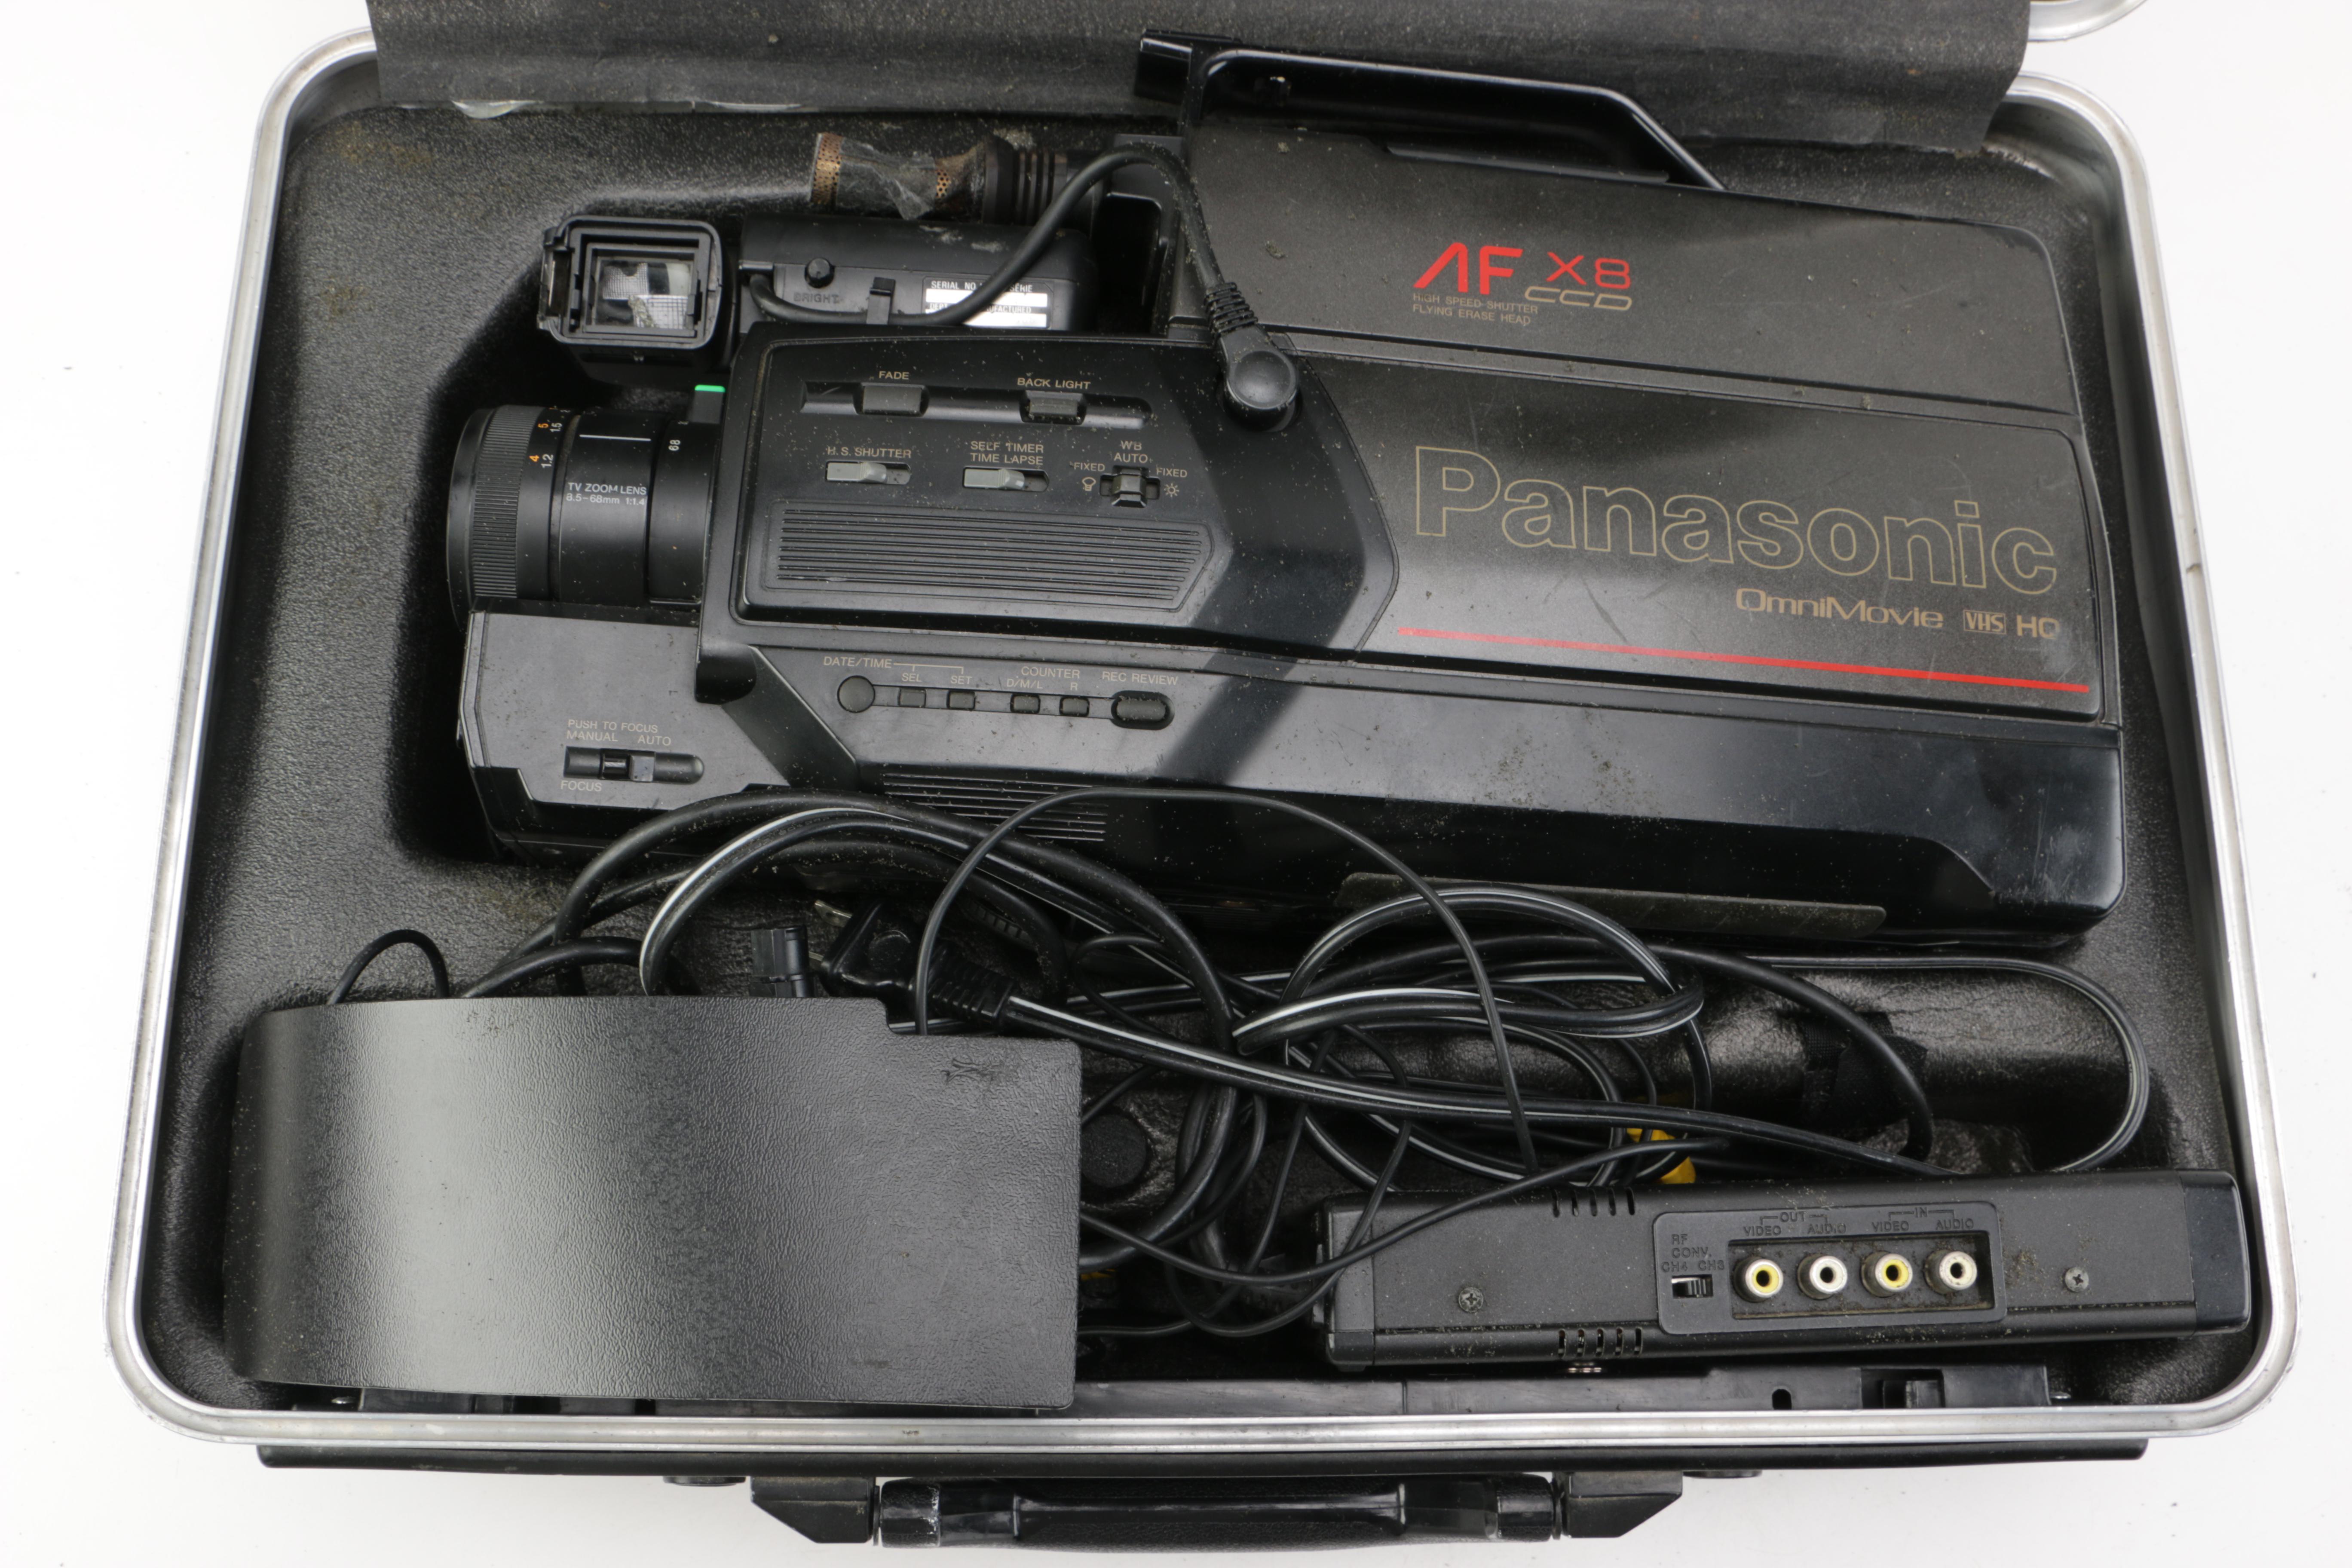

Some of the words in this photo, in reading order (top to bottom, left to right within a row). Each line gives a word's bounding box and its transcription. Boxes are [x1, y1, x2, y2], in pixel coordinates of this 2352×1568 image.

[1413, 242, 1523, 295] AF
[1546, 251, 1631, 289] X8
[931, 280, 959, 289] SERIAL
[794, 292, 839, 303] BRIGHT
[1413, 293, 1439, 303] HIGH
[1445, 296, 1481, 308] SPEED
[1487, 300, 1538, 314] SHUTTER
[1524, 286, 1632, 311] CCD
[1413, 304, 1452, 316] FLYING
[1458, 309, 1495, 321] ERASE
[1501, 314, 1531, 325] HEAD
[879, 371, 909, 380] FADE
[1017, 377, 1050, 387] BACK
[1056, 380, 1091, 389] LIGHT
[668, 439, 681, 451] 68
[971, 441, 1000, 451] SELF
[1007, 442, 1044, 453] TIMER
[1121, 440, 1142, 450] WB
[854, 447, 912, 458] SHUTTER
[1114, 453, 1148, 463] AUTO
[541, 454, 554, 468] 1.2
[970, 453, 1000, 462] TIME
[1004, 454, 1044, 465] LAPSE
[1074, 462, 1105, 472] FIXED
[1156, 467, 1188, 478] FIXED
[568, 482, 582, 492] TV
[585, 483, 618, 493] ZOOM
[620, 486, 647, 495] LENS
[625, 496, 645, 506] 1:1.4
[1414, 445, 2058, 594] Panasonic
[1736, 588, 1944, 628] OmniMovie
[1964, 610, 2005, 634] VHS
[2016, 614, 2060, 640] HQ
[823, 656, 893, 668] DATE/TIME
[901, 673, 922, 682] SEL
[1021, 666, 1080, 679] COUNTER
[1102, 671, 1127, 682] REC
[1131, 673, 1178, 686] REVIEW
[950, 675, 972, 684] SET
[1006, 678, 1043, 689] D/M/L
[1070, 682, 1078, 691] R
[568, 719, 597, 730] PUSH
[602, 721, 617, 730] TO
[621, 722, 658, 733] FOCUS
[567, 730, 619, 742] MANUAL
[637, 734, 671, 746] AUTO
[560, 780, 602, 792] FOCUS
[1779, 1211, 1807, 1223] OUT
[1914, 1207, 1928, 1218] IN
[1807, 1222, 1847, 1235] AUDIO
[1871, 1220, 1910, 1232] VIDEO
[1936, 1218, 1974, 1231] AUDIO
[1743, 1225, 1782, 1237] VIDEO
[1671, 1234, 1688, 1245] RF
[1671, 1246, 1712, 1259] CONV.
[1660, 1261, 1688, 1273] CH4
[1698, 1259, 1725, 1271] CH3
